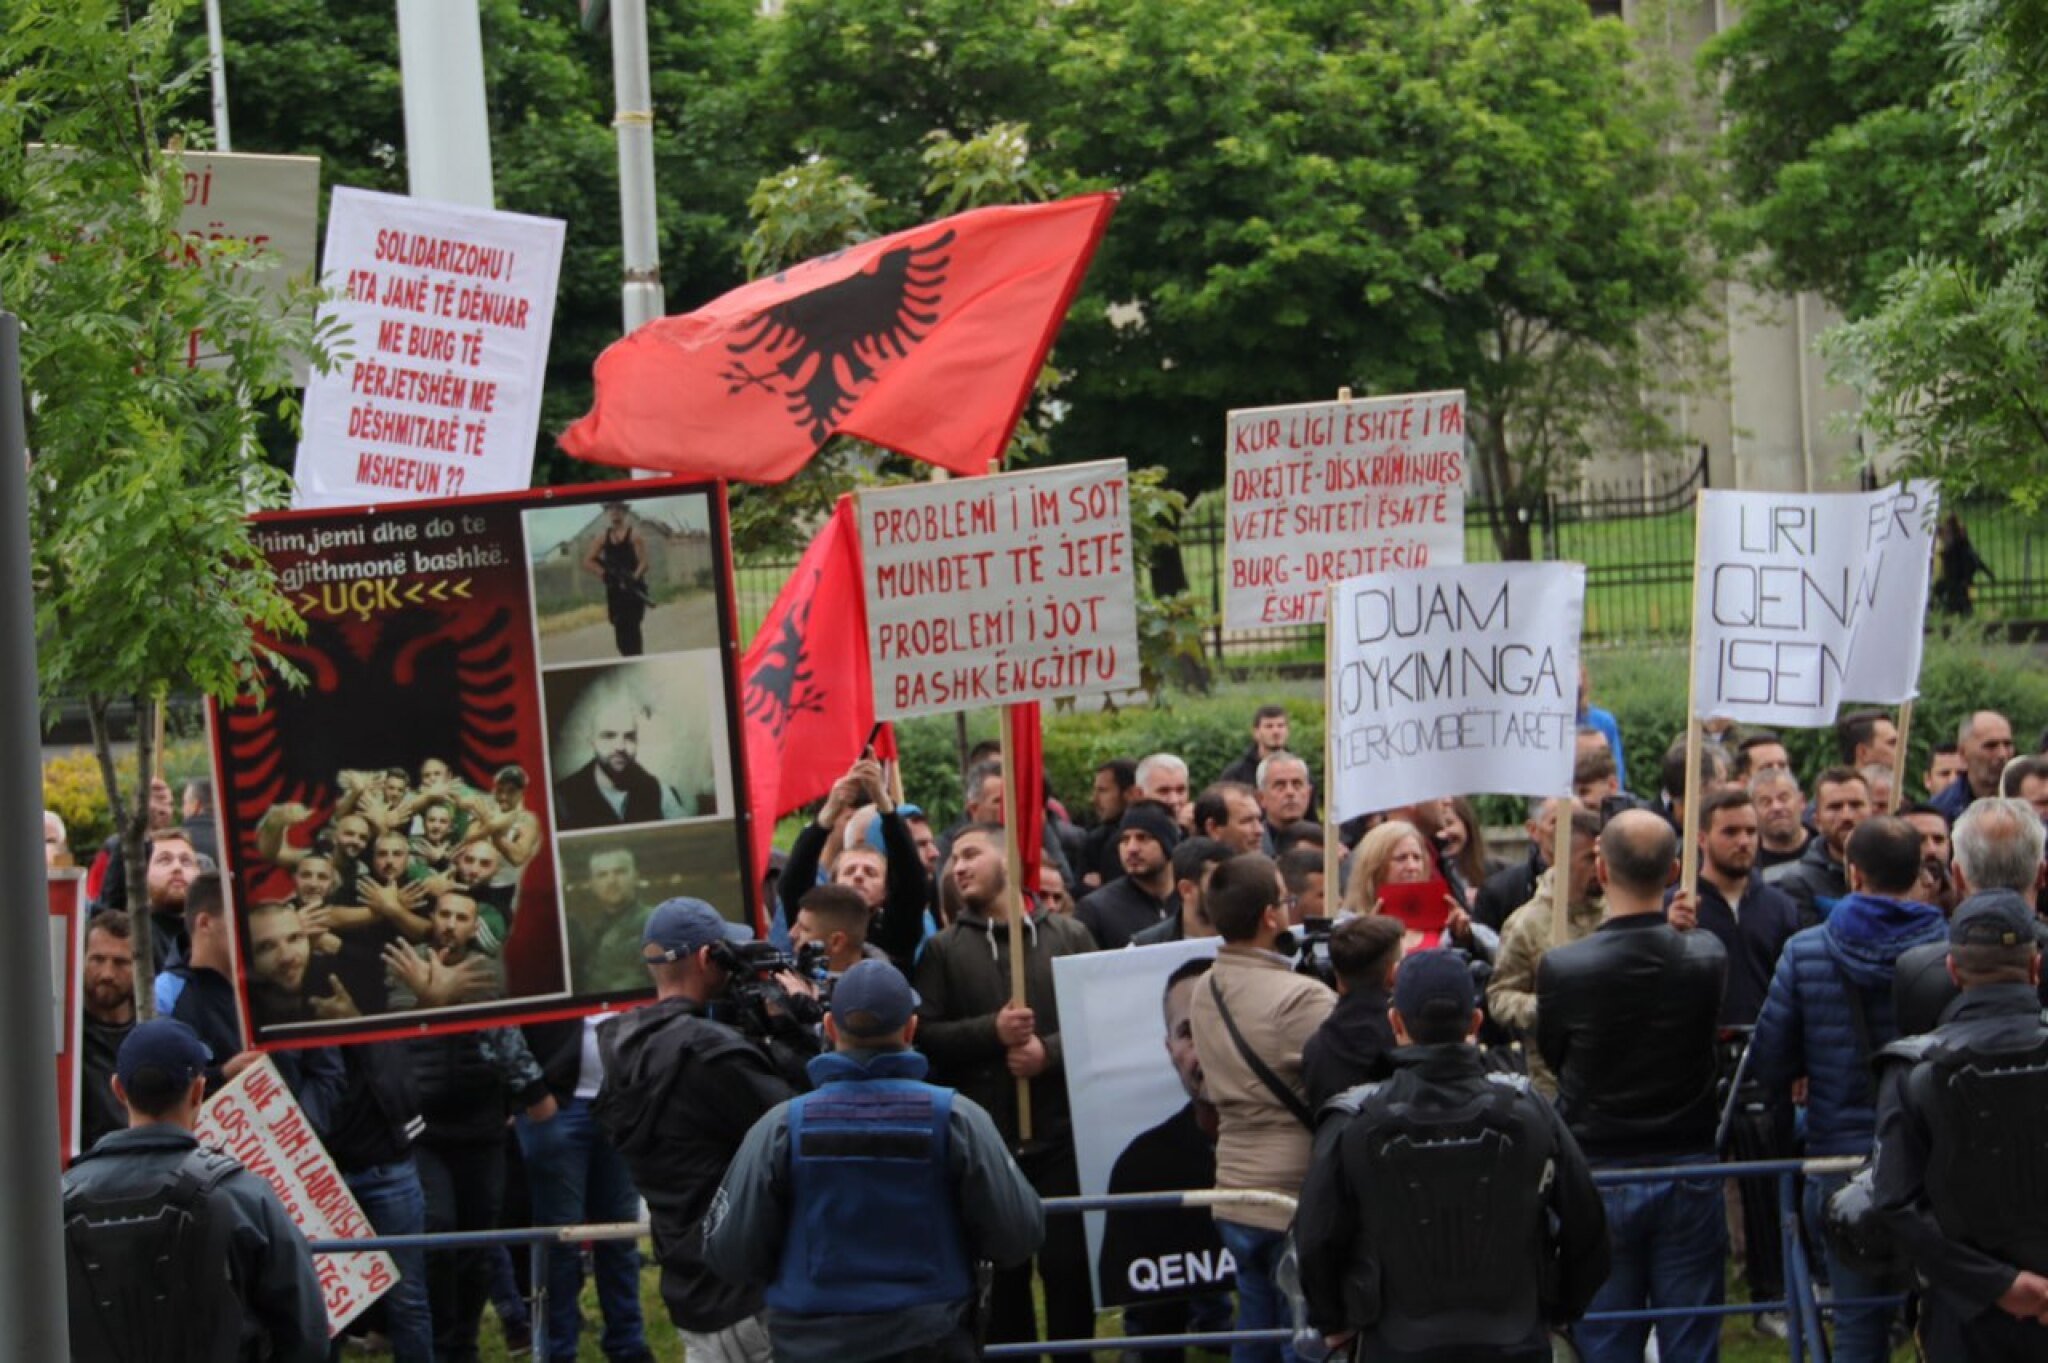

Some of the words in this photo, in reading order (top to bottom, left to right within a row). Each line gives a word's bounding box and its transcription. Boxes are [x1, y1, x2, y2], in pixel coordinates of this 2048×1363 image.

[375, 228, 504, 281] SOLIDARIZOHU
[346, 269, 377, 304] ATA
[382, 274, 430, 313] JANË
[434, 280, 456, 317] TË
[458, 285, 529, 330] DËNUAR
[378, 320, 405, 353] ME
[407, 325, 457, 361] BURG
[462, 328, 483, 366] TË
[352, 357, 467, 409] PËRJETSHËM
[469, 380, 497, 413] ME
[348, 402, 459, 452] DËSHMITARË
[464, 419, 486, 456] TË
[1235, 419, 1281, 455] KUR
[356, 453, 441, 494] MSHEFUN
[1068, 479, 1124, 524] SOT
[373, 521, 417, 544] dhe
[425, 517, 455, 538] do
[461, 514, 486, 535] te
[1740, 504, 1817, 555] LIRI
[282, 553, 407, 592] gjithmonë
[876, 551, 995, 600] MUNDET
[1260, 587, 1328, 624] ËSHT
[1354, 579, 1510, 645] DUAM
[1127, 1247, 1238, 1292] QENA
